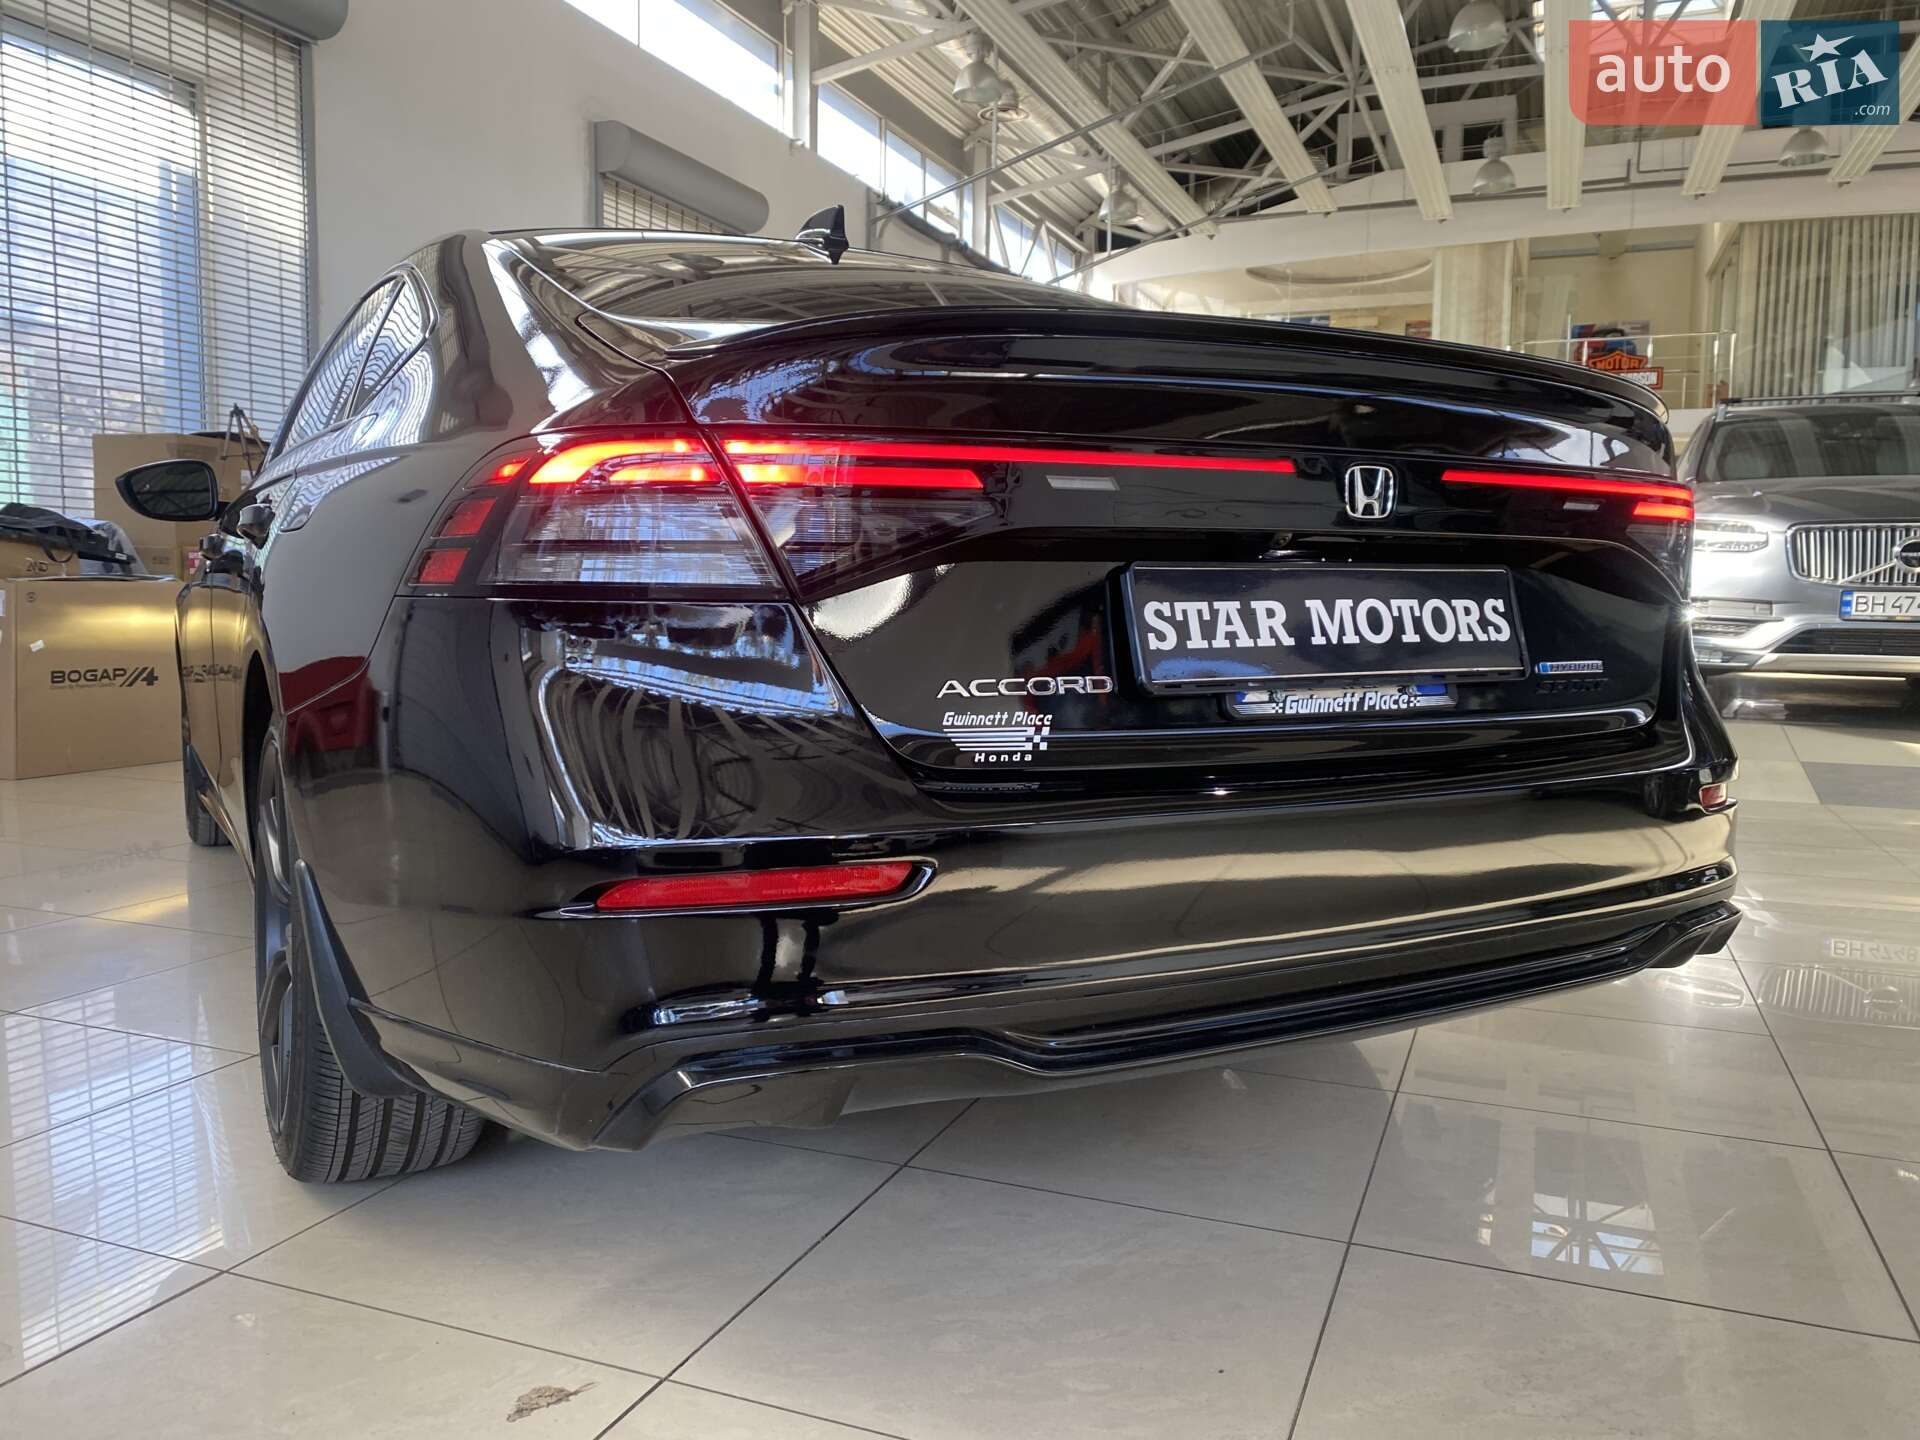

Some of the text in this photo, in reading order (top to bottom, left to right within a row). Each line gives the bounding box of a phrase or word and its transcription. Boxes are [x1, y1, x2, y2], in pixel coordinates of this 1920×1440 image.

[1596, 354, 1640, 370] MOTOR
[1854, 595, 1920, 614] BH 47
[1143, 598, 1511, 651] STAR MOTORS
[936, 675, 1113, 699] ACCORD
[1285, 691, 1409, 715] Gwinnett Place
[942, 711, 1053, 726] Gwinnett Place
[974, 752, 1033, 763] Honda
